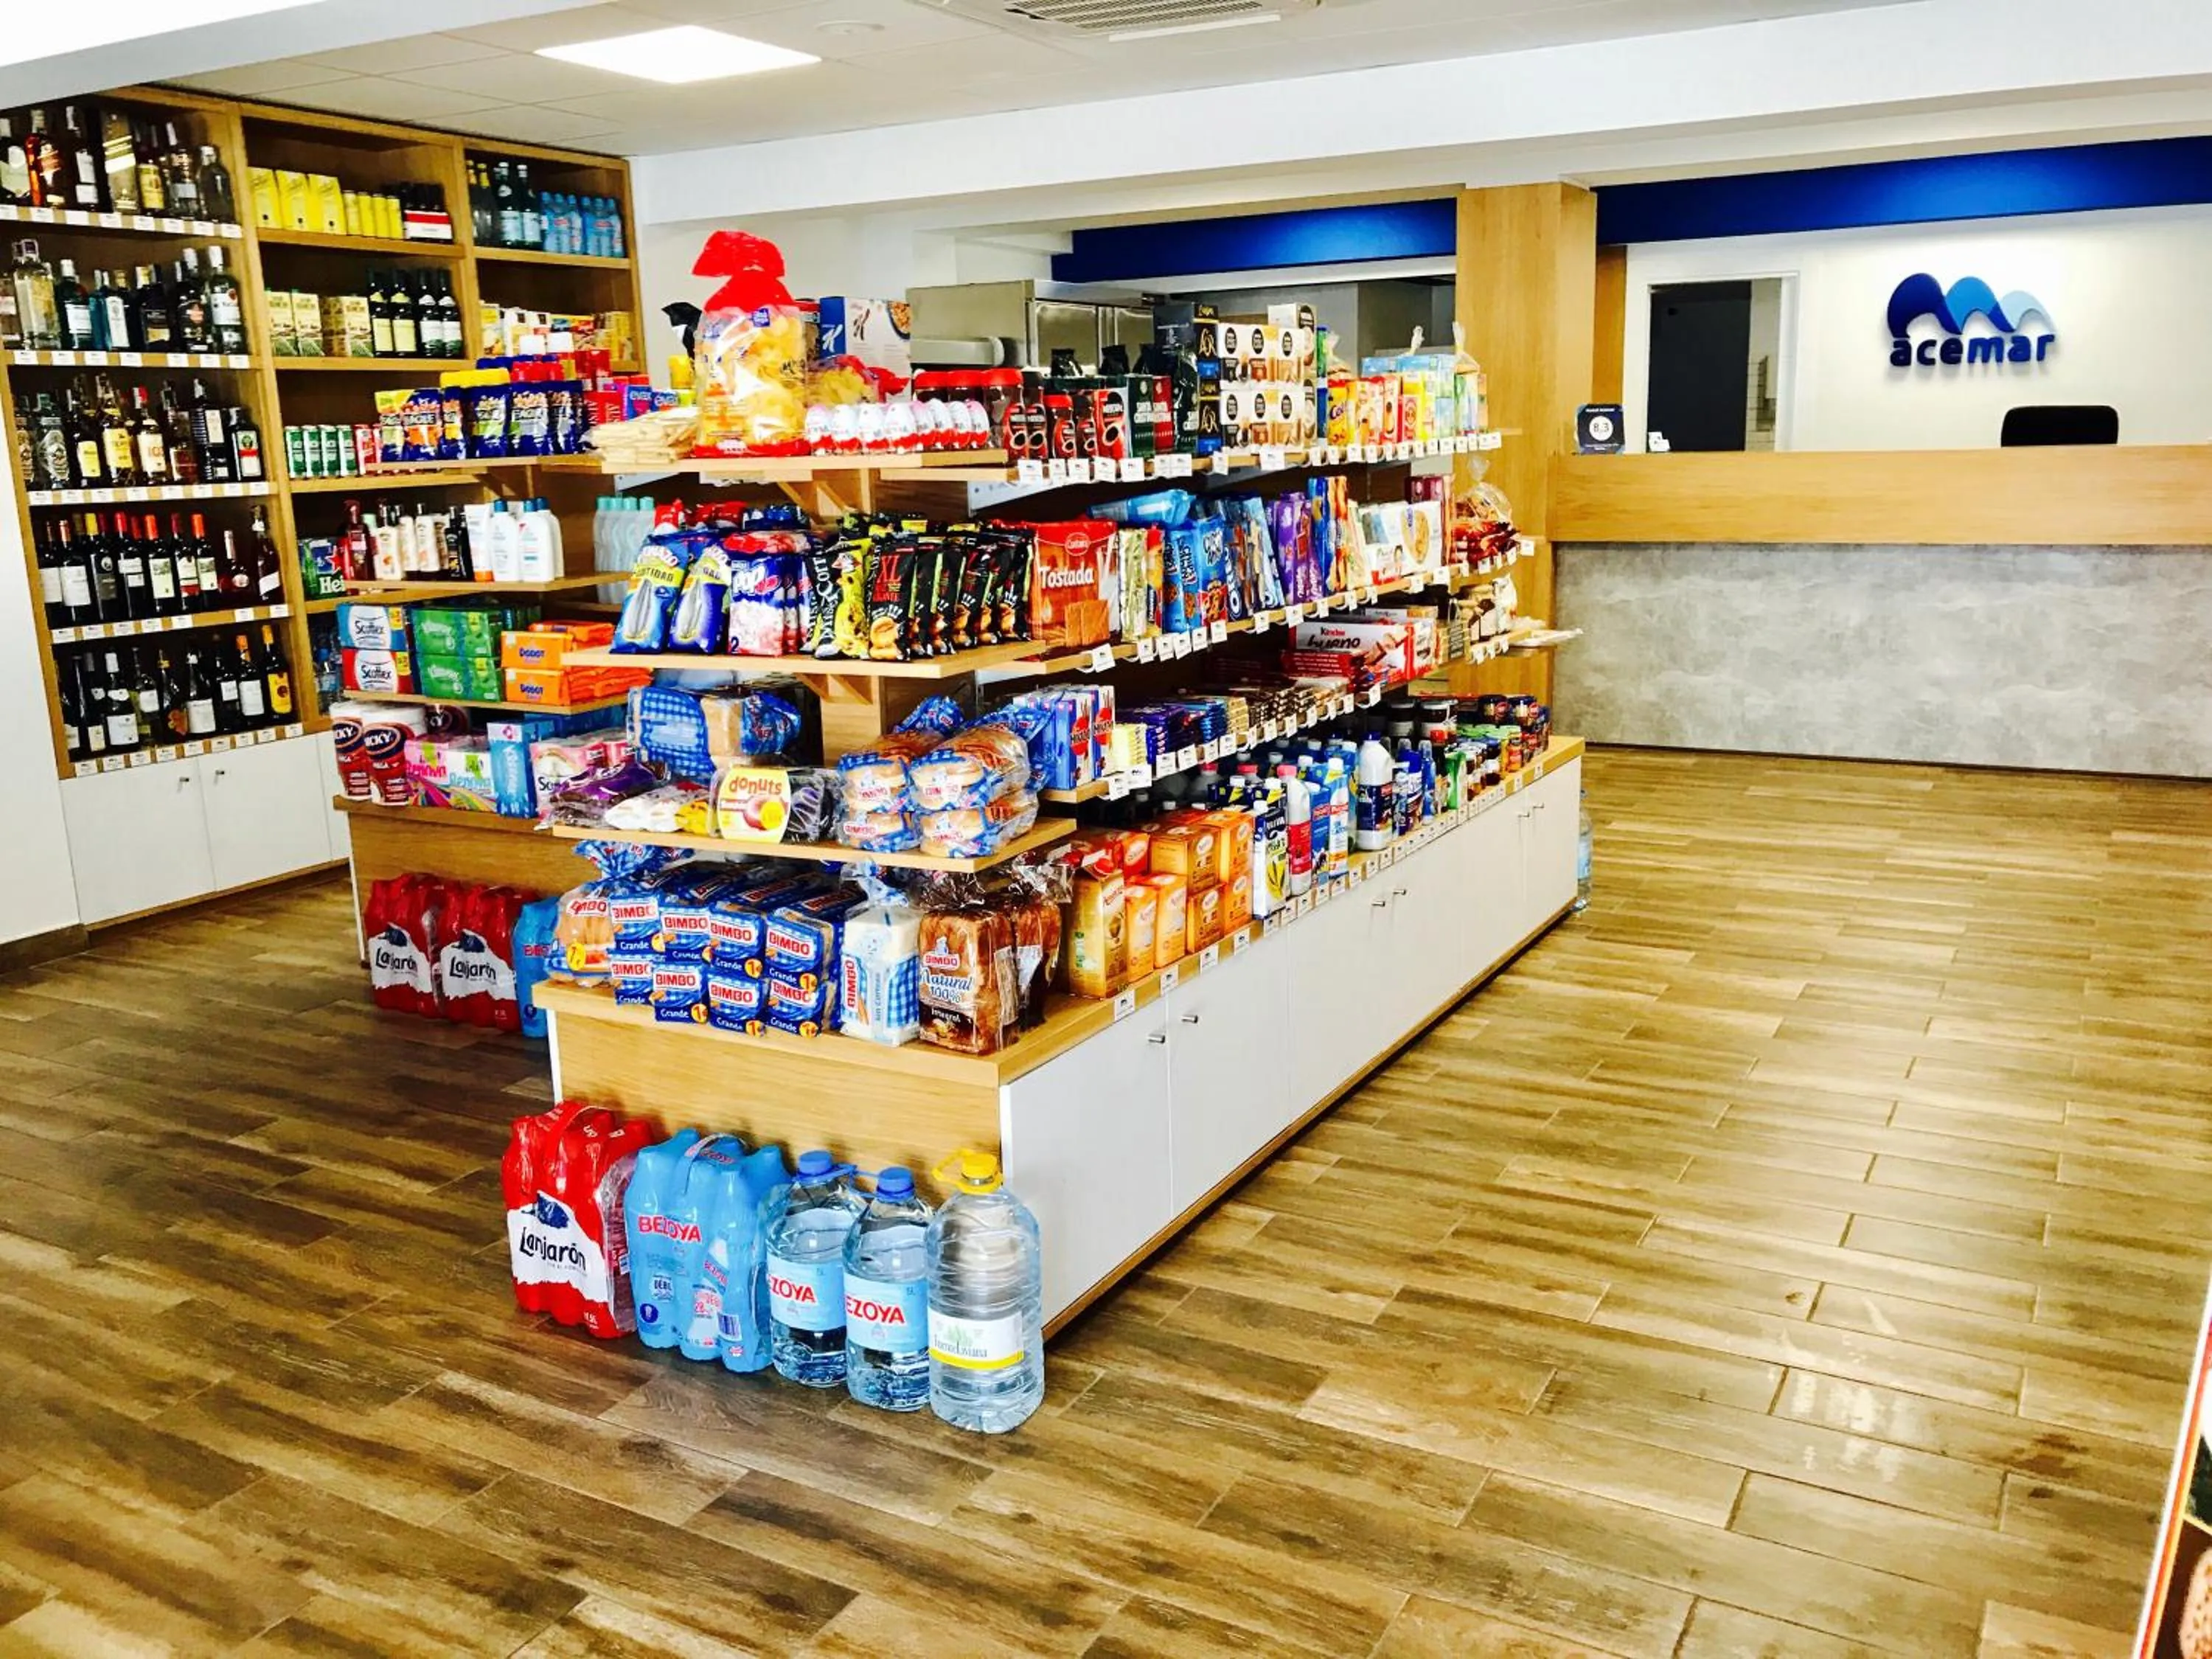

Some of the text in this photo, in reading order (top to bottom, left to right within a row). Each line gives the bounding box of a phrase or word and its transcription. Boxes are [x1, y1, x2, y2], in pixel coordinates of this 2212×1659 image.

[1889, 334, 2055, 366] acemar
[1038, 561, 1094, 588] Tostada
[728, 776, 783, 796] donuts
[612, 905, 656, 919] BIMBO
[664, 917, 709, 929] BIMBO
[710, 922, 752, 942] BIMBO
[620, 941, 650, 950] Grande
[768, 931, 810, 956] BIMBO
[375, 948, 418, 969] Lajarón
[449, 956, 496, 981] Lajarn
[715, 958, 742, 971] Grande
[925, 955, 958, 966] BIMBO
[655, 973, 696, 987] BIMBO
[769, 967, 797, 984] Grande
[919, 967, 973, 991] Natural
[710, 984, 753, 1004] BIMBO
[773, 981, 811, 1004] BIMBO
[660, 1009, 689, 1018] Grande
[716, 1017, 743, 1031] Grande
[771, 1017, 797, 1033] Grande
[519, 1227, 587, 1271] Lanjarón
[768, 1276, 816, 1304] ZOYA
[845, 1296, 905, 1324] EZOYA
